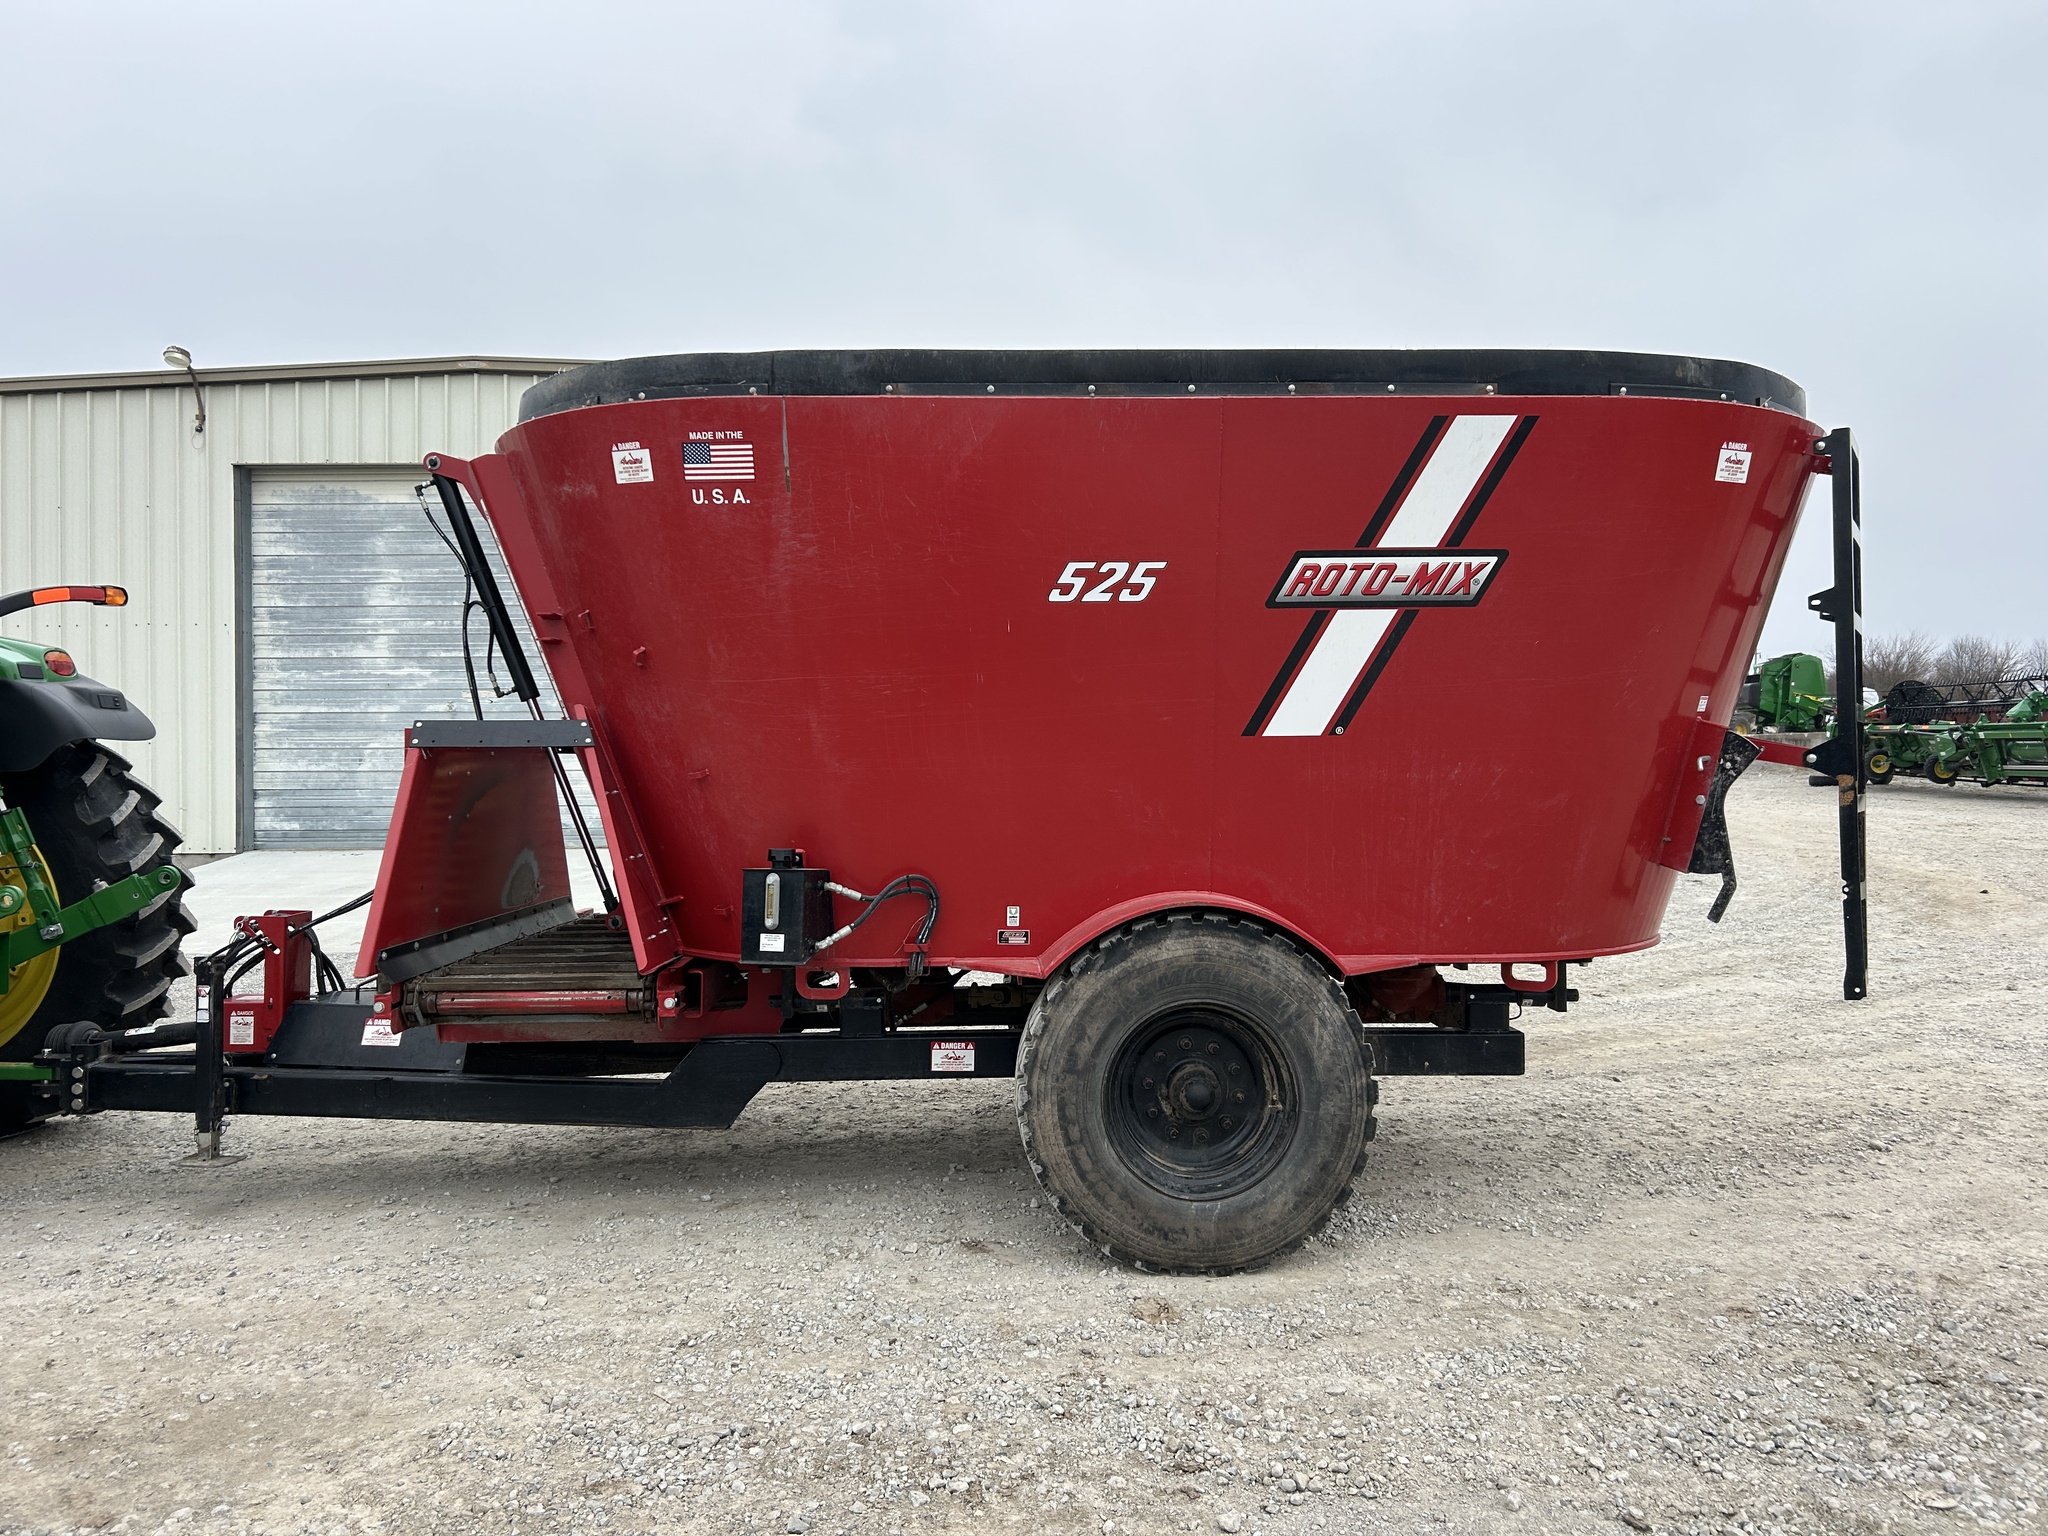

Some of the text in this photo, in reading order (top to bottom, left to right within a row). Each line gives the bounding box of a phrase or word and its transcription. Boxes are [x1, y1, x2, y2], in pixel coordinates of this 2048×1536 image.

[689, 431, 744, 440] MADE IN THE
[617, 441, 641, 451] DANGER
[1728, 441, 1748, 451] DANGER
[1048, 561, 1168, 602] 525
[1284, 561, 1491, 597] ROTO-MIX
[940, 1042, 966, 1050] DANGER
